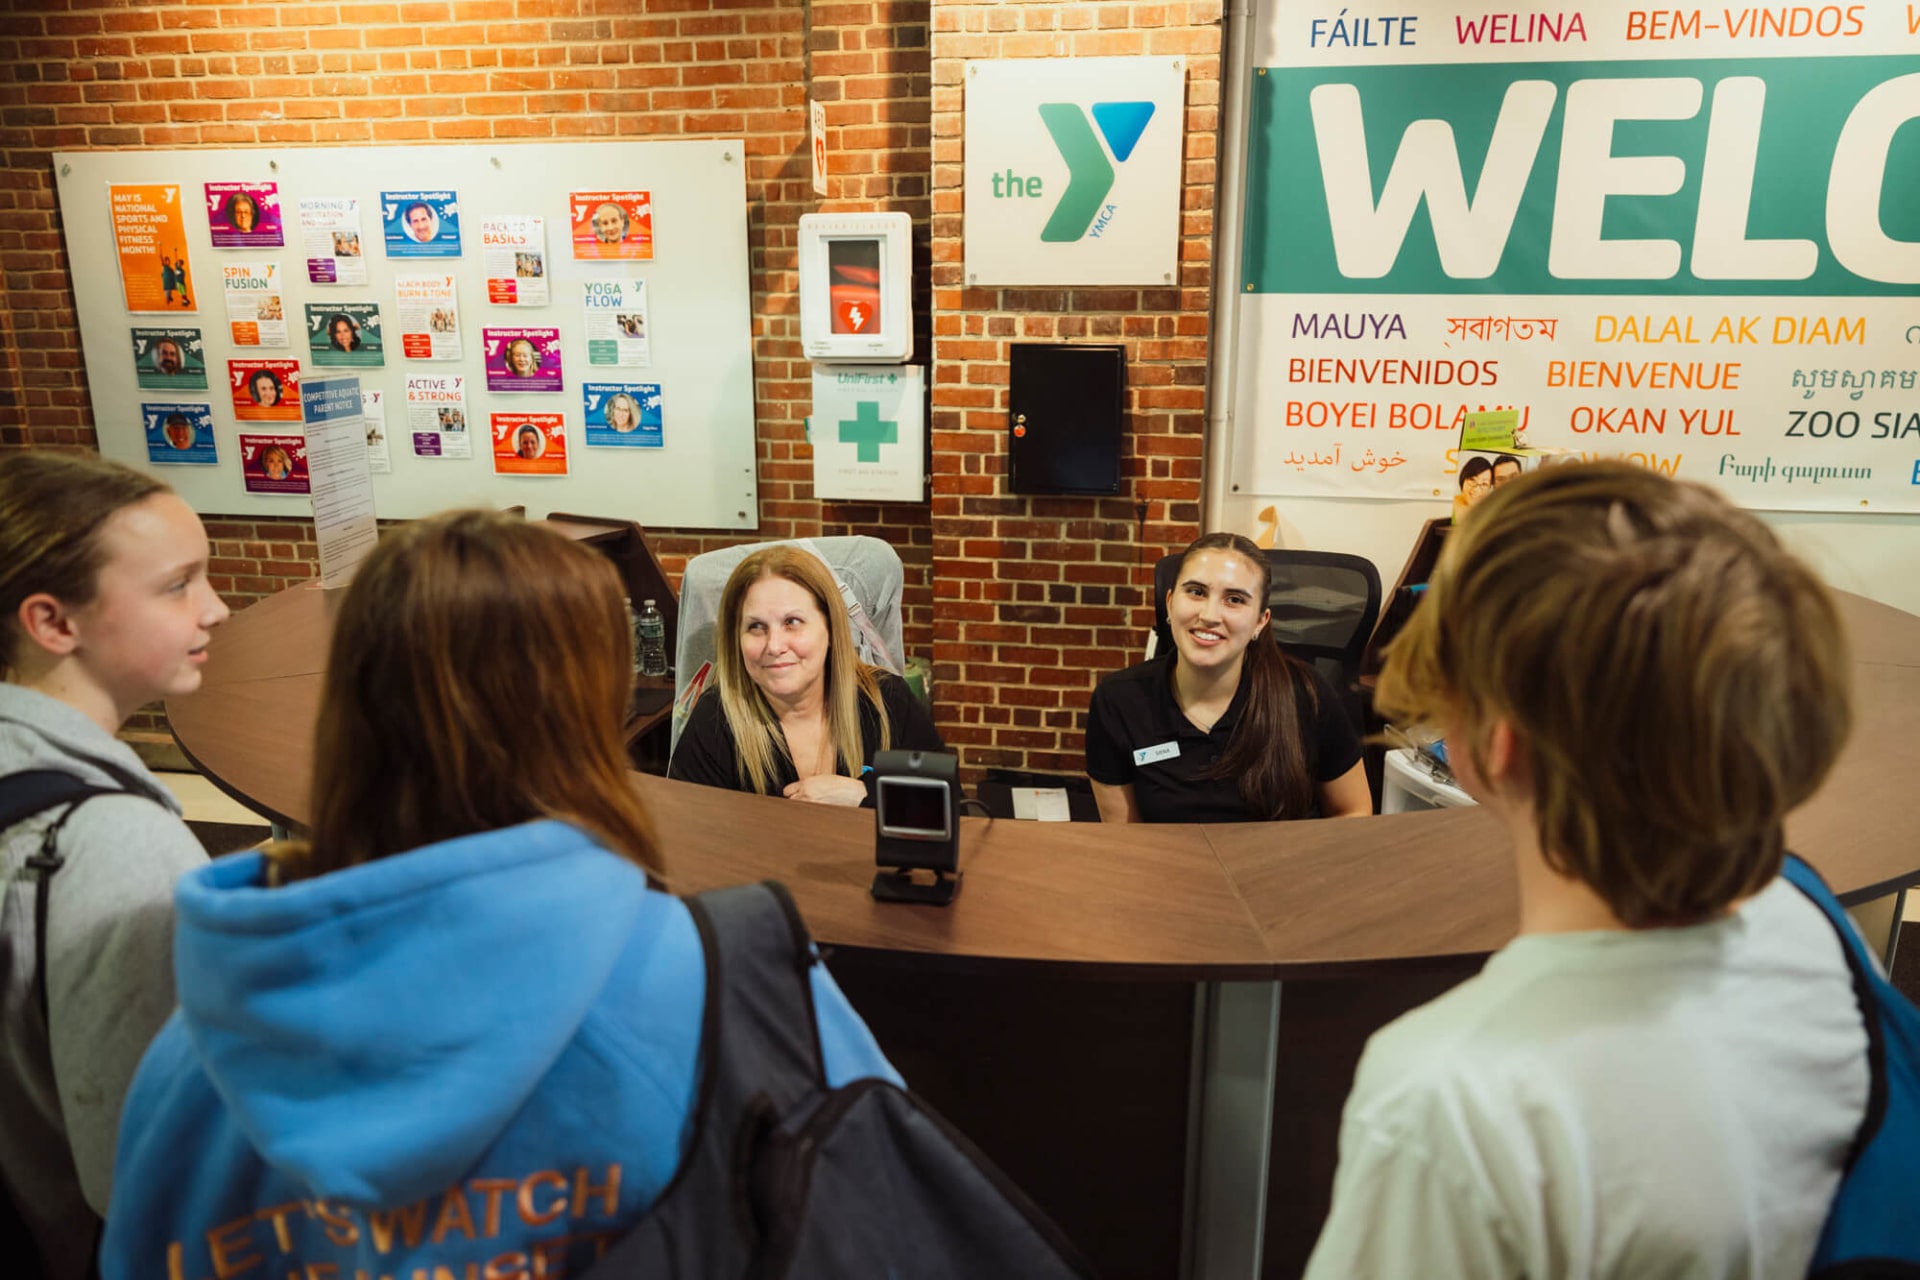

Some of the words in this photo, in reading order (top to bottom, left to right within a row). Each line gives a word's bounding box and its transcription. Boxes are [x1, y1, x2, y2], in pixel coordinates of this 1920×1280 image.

[1310, 8, 1418, 48] FÁILTE
[1455, 12, 1588, 45] WELINA
[1626, 5, 1865, 42] BEM-VINDOS
[992, 169, 1043, 198] the
[114, 194, 132, 202] MAY
[133, 194, 142, 202] IS
[420, 192, 451, 201] Spotlight
[611, 193, 644, 202] Spotlight
[115, 204, 157, 212] NATIONAL
[116, 214, 149, 223] SPORTS
[150, 214, 168, 223] AND
[1088, 203, 1118, 240] YMCA
[118, 225, 157, 233] PHYSICAL
[120, 235, 154, 244] FITNESS
[224, 266, 250, 278] SPIN
[225, 278, 268, 289] FUSION
[585, 282, 621, 294] YOGA
[585, 295, 622, 307] FLOW
[343, 305, 374, 313] Spotlight
[1292, 313, 1407, 340] MAUYA
[1594, 315, 1701, 344] DALAL
[1710, 316, 1762, 345] AK
[1772, 316, 1867, 345] DIAM
[522, 329, 554, 338] Spotlight
[1289, 358, 1499, 386] BIENVENIDOS
[1547, 361, 1742, 390] BIENVENUE
[837, 372, 885, 385] UniFirst
[408, 380, 446, 390] ACTIVE
[588, 384, 622, 392] Instructor
[623, 384, 655, 394] Spotlight
[408, 391, 416, 401] &
[418, 391, 462, 401] STRONG
[314, 402, 334, 414] PARENT
[335, 400, 353, 410] NOTICE
[1285, 401, 1376, 428] BOYEI
[1570, 407, 1667, 435] OKAN
[1679, 409, 1741, 436] YUL
[1785, 411, 1860, 438] ZOO
[1351, 449, 1407, 474] خوش
[368, 1163, 622, 1254] WATCH
